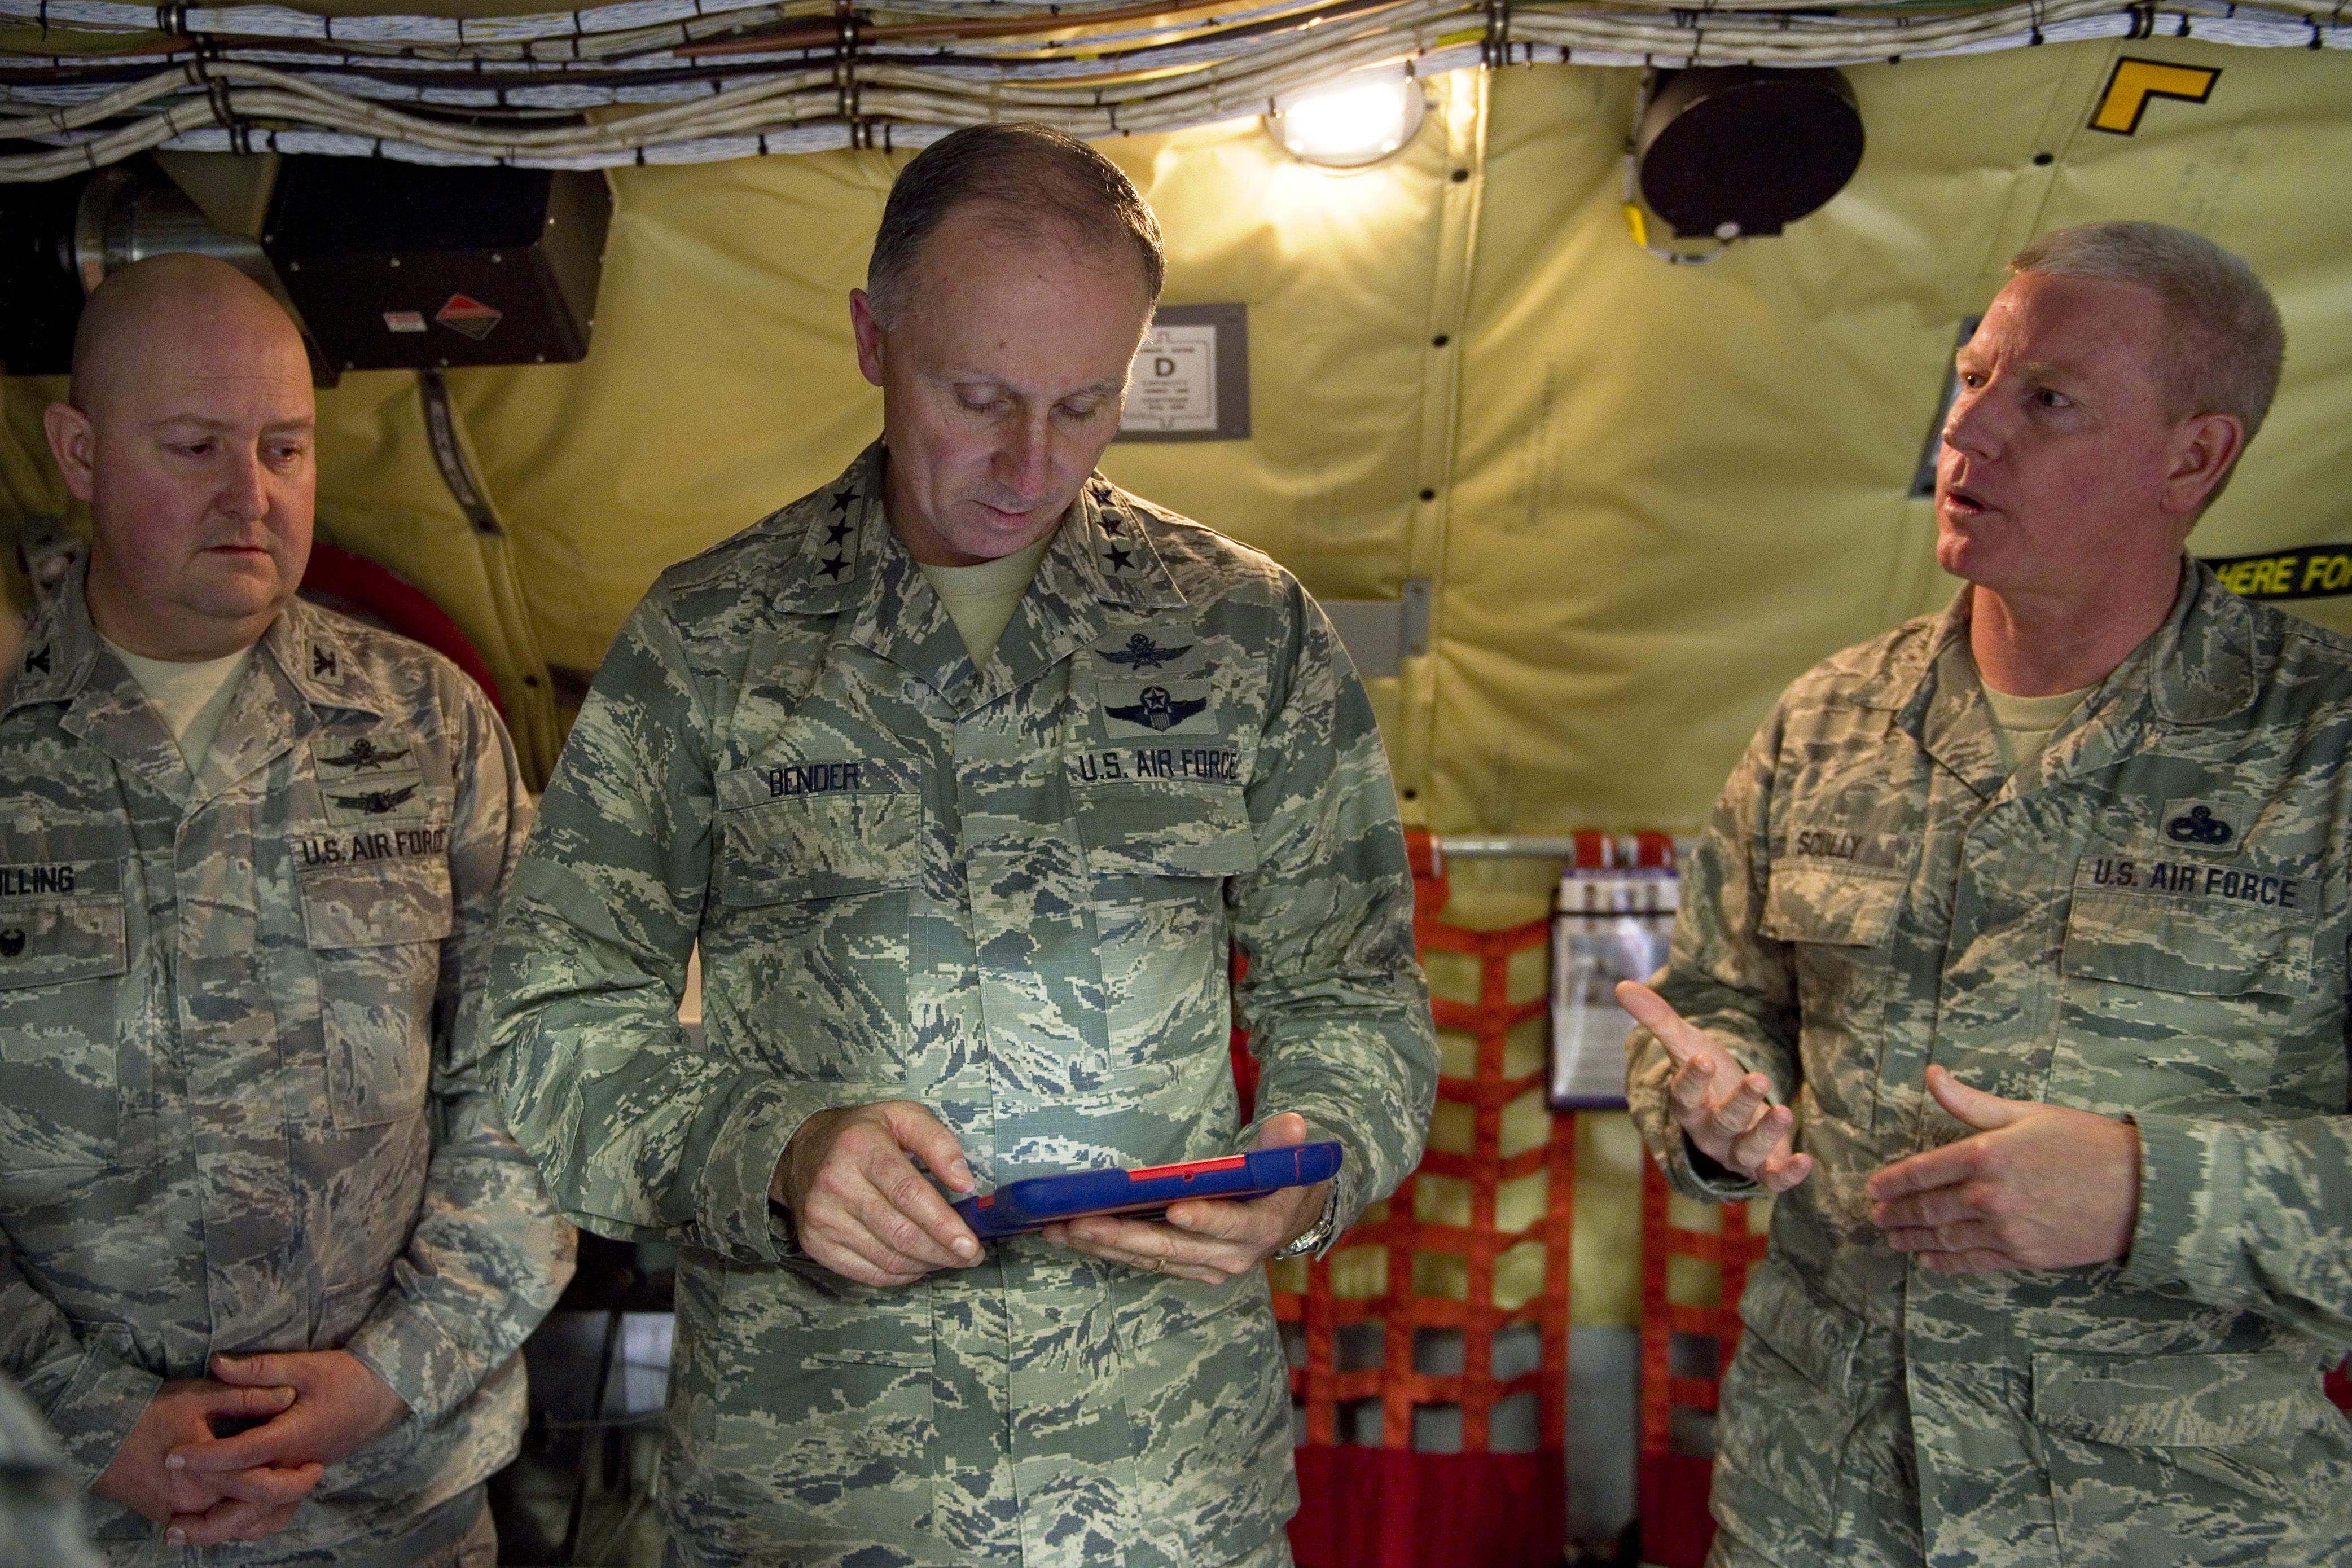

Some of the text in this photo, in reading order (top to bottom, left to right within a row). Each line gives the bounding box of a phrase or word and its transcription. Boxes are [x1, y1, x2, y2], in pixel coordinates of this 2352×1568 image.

[1155, 357, 1175, 377] D
[2301, 555, 2352, 591] FO
[770, 763, 860, 797] BENDER
[1078, 749, 1238, 781] U.S. AIR FORCE
[302, 838, 346, 864] U.S.
[352, 833, 393, 861] AIR
[2094, 858, 2297, 908] U.S. AIR FORCE
